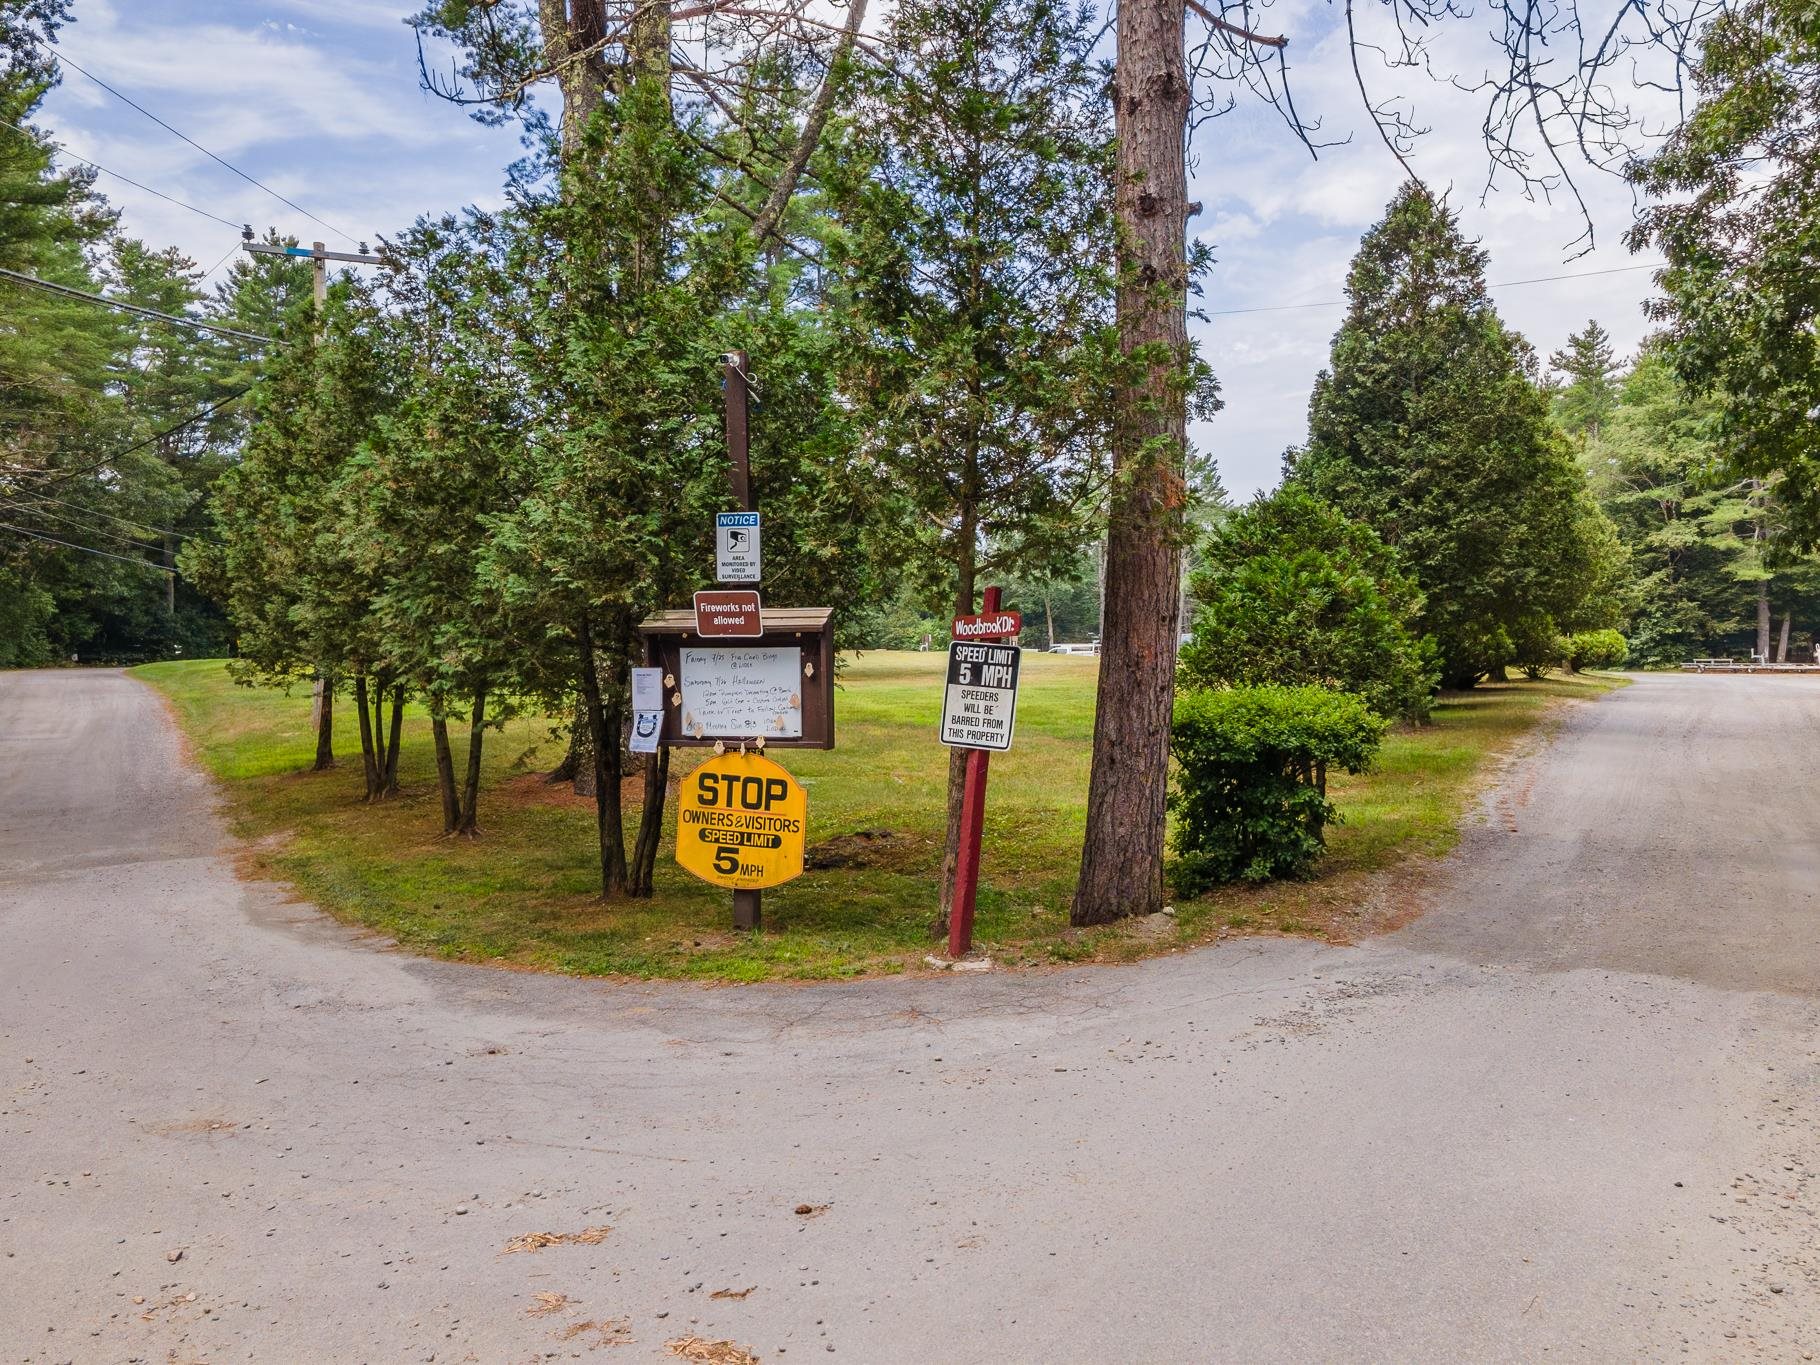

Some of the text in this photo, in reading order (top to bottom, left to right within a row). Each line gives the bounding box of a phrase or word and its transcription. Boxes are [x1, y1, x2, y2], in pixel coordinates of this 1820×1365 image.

[720, 515, 756, 525] NOTICE
[700, 602, 756, 612] Fireworks not
[713, 616, 745, 625] allowed
[955, 646, 1015, 665] SPEED LIMIT
[959, 663, 1013, 688] 5 MPH
[961, 689, 999, 702] SPEEDERS
[964, 703, 994, 715] WILL BE
[951, 715, 1004, 729] BARRED FROM
[948, 728, 1005, 743] THIS PROPERTY
[697, 772, 788, 811] STOP
[682, 809, 800, 833] OWNERS & VISITORS
[704, 829, 775, 847] SPEED LIMIT
[712, 846, 764, 877] 5 MPH
